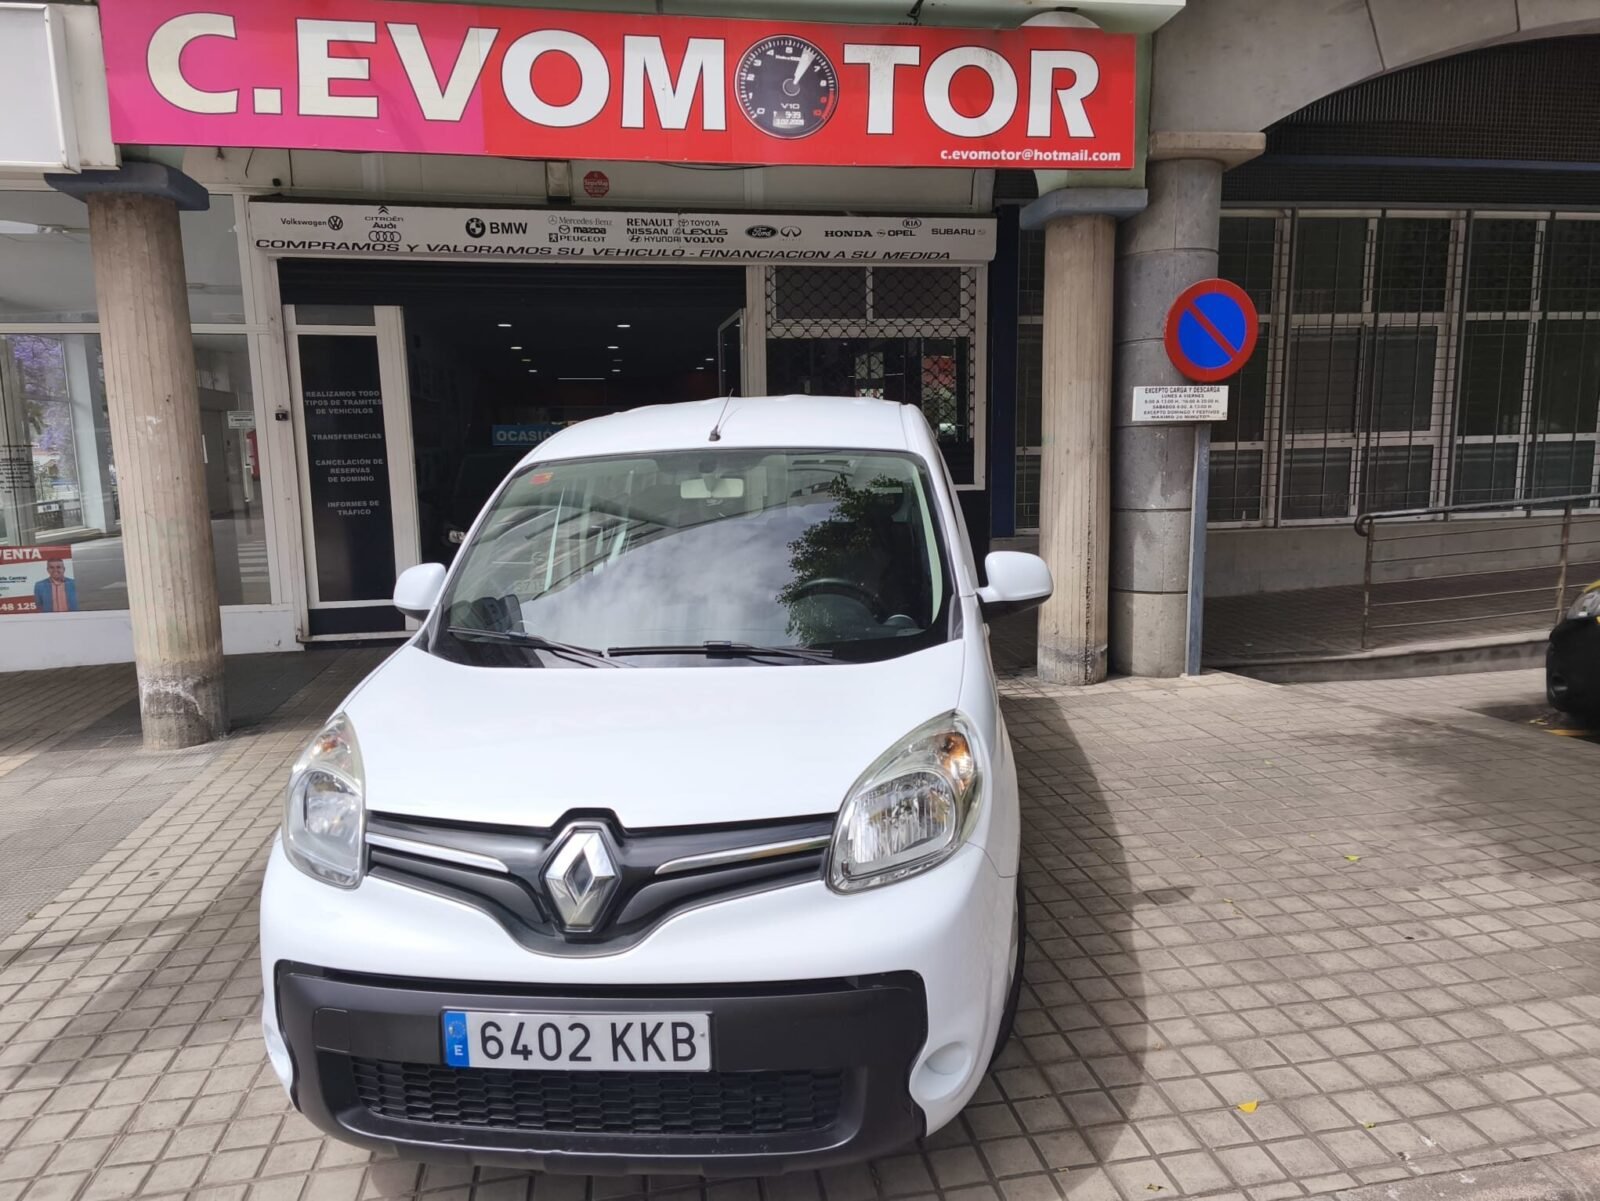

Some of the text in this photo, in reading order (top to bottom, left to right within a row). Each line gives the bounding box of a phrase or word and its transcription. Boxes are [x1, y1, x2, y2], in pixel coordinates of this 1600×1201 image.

[940, 149, 1121, 162] c.evomotor@hotmail.com
[281, 218, 327, 227] Volkswagen
[559, 216, 612, 226] Mercedes-Benz
[627, 218, 674, 227] RENAULT
[489, 222, 528, 235] BMW
[573, 226, 607, 235] mazda
[682, 228, 728, 236] LEXUS
[887, 229, 916, 237] OPEL
[931, 228, 975, 236] SUBARU
[824, 230, 873, 238] HONDA
[255, 239, 400, 252] COMPRAMOS
[406, 244, 419, 252] Y
[426, 244, 552, 255] VALORAMOS
[557, 247, 584, 256] SU
[592, 247, 686, 257] VEHICULO
[699, 249, 831, 259] FINANCIACION
[833, 251, 846, 259] A
[851, 251, 877, 259] SU
[882, 251, 951, 260] MEDIDA
[311, 433, 382, 441] TRANSFERENCIAS
[0, 548, 42, 560] ENTA
[17, 602, 37, 611] 125
[480, 1021, 697, 1063] 6402 KKB
[454, 1044, 463, 1056] E
